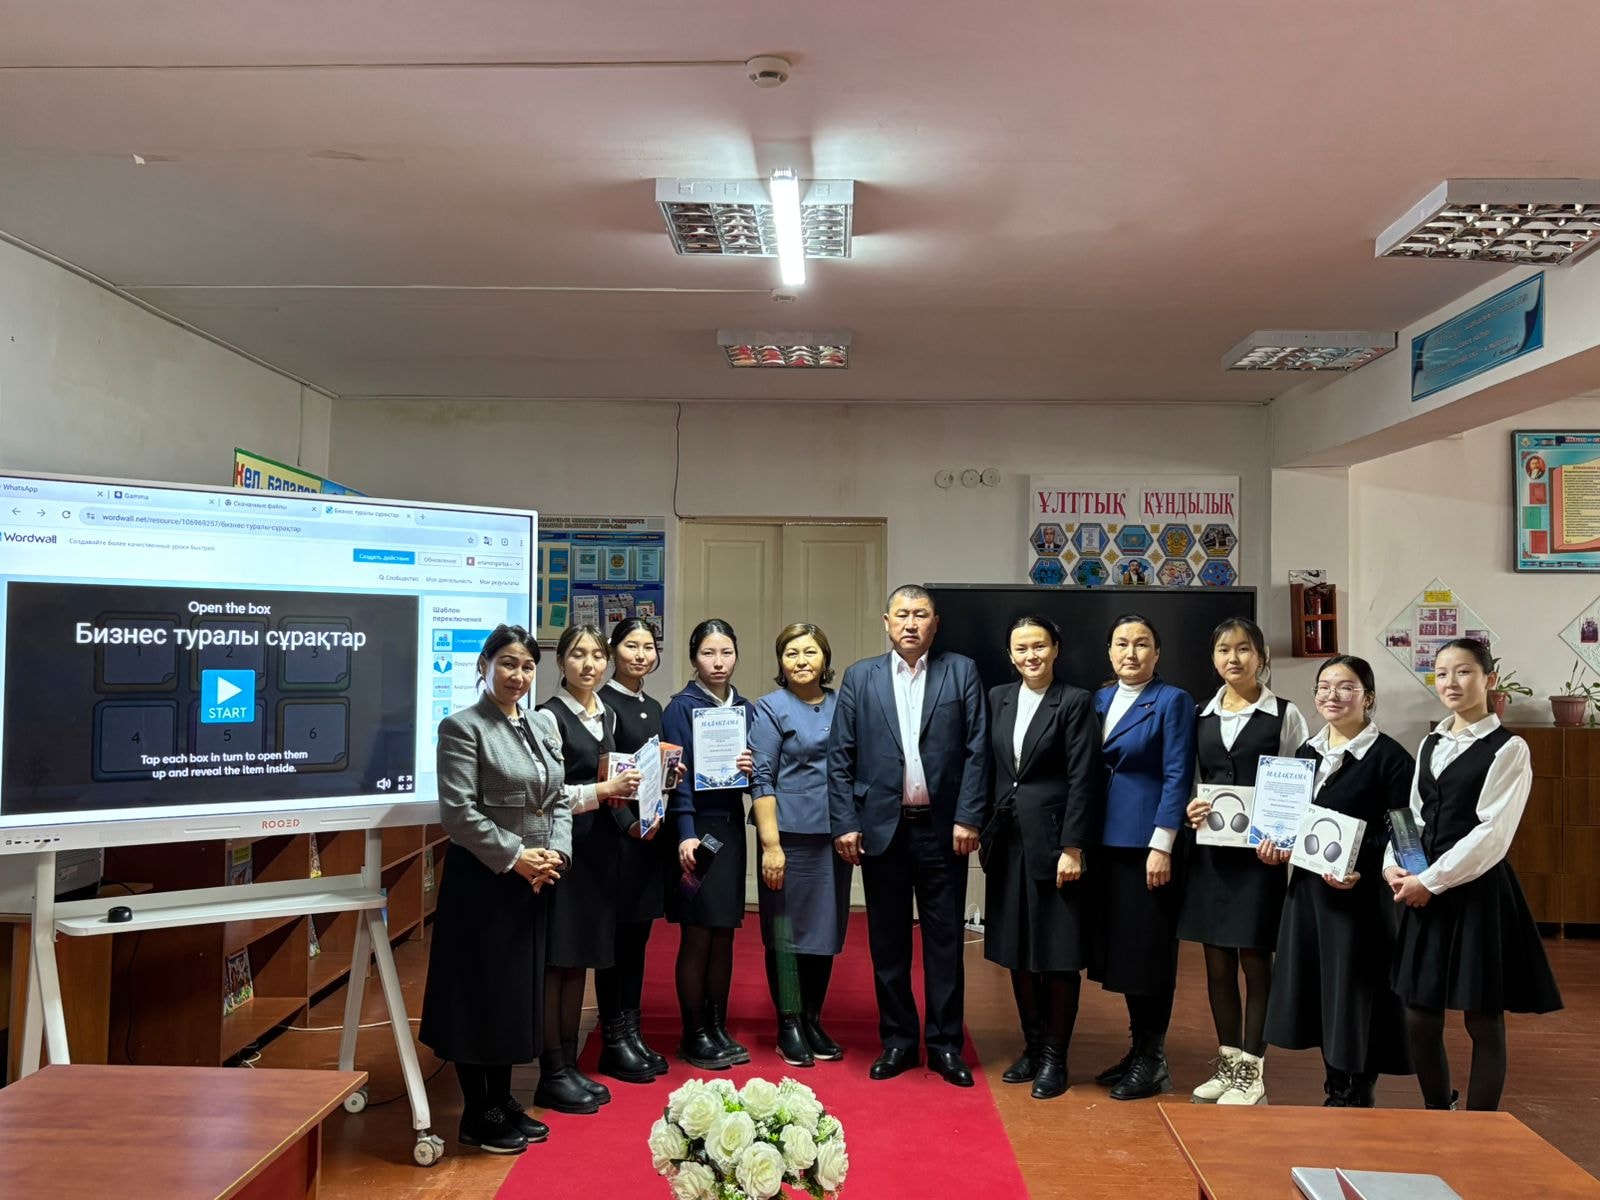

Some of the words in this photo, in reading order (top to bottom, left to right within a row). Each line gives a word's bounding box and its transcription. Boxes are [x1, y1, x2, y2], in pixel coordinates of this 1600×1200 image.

[3, 484, 38, 493] WhatsApp
[1038, 491, 1127, 518] ҰЛТТЫҚ
[1143, 492, 1234, 519] ҚҰНДЫЛЫҚ
[4, 531, 57, 544] Wordwall
[188, 601, 223, 616] Open
[225, 602, 245, 615] the
[248, 602, 271, 615] box
[75, 622, 167, 645] Бизнес
[173, 627, 259, 651] туралы
[265, 626, 366, 651] сұрақтар
[225, 646, 234, 658] 2
[208, 707, 248, 719] START
[131, 732, 140, 744] 4
[223, 729, 232, 741] 5
[309, 728, 317, 740] 6
[140, 754, 160, 767] Tap
[162, 753, 187, 764] each
[189, 753, 208, 764] box
[210, 752, 220, 763] in
[222, 752, 242, 762] turn
[245, 752, 255, 762] to
[257, 752, 282, 764] open
[284, 750, 308, 760] them
[152, 770, 167, 780] up
[168, 768, 188, 779] and
[191, 767, 222, 777] reveal
[224, 766, 240, 776] the
[242, 765, 264, 775] item
[267, 764, 297, 775] inside.
[262, 819, 300, 829] ROQED
